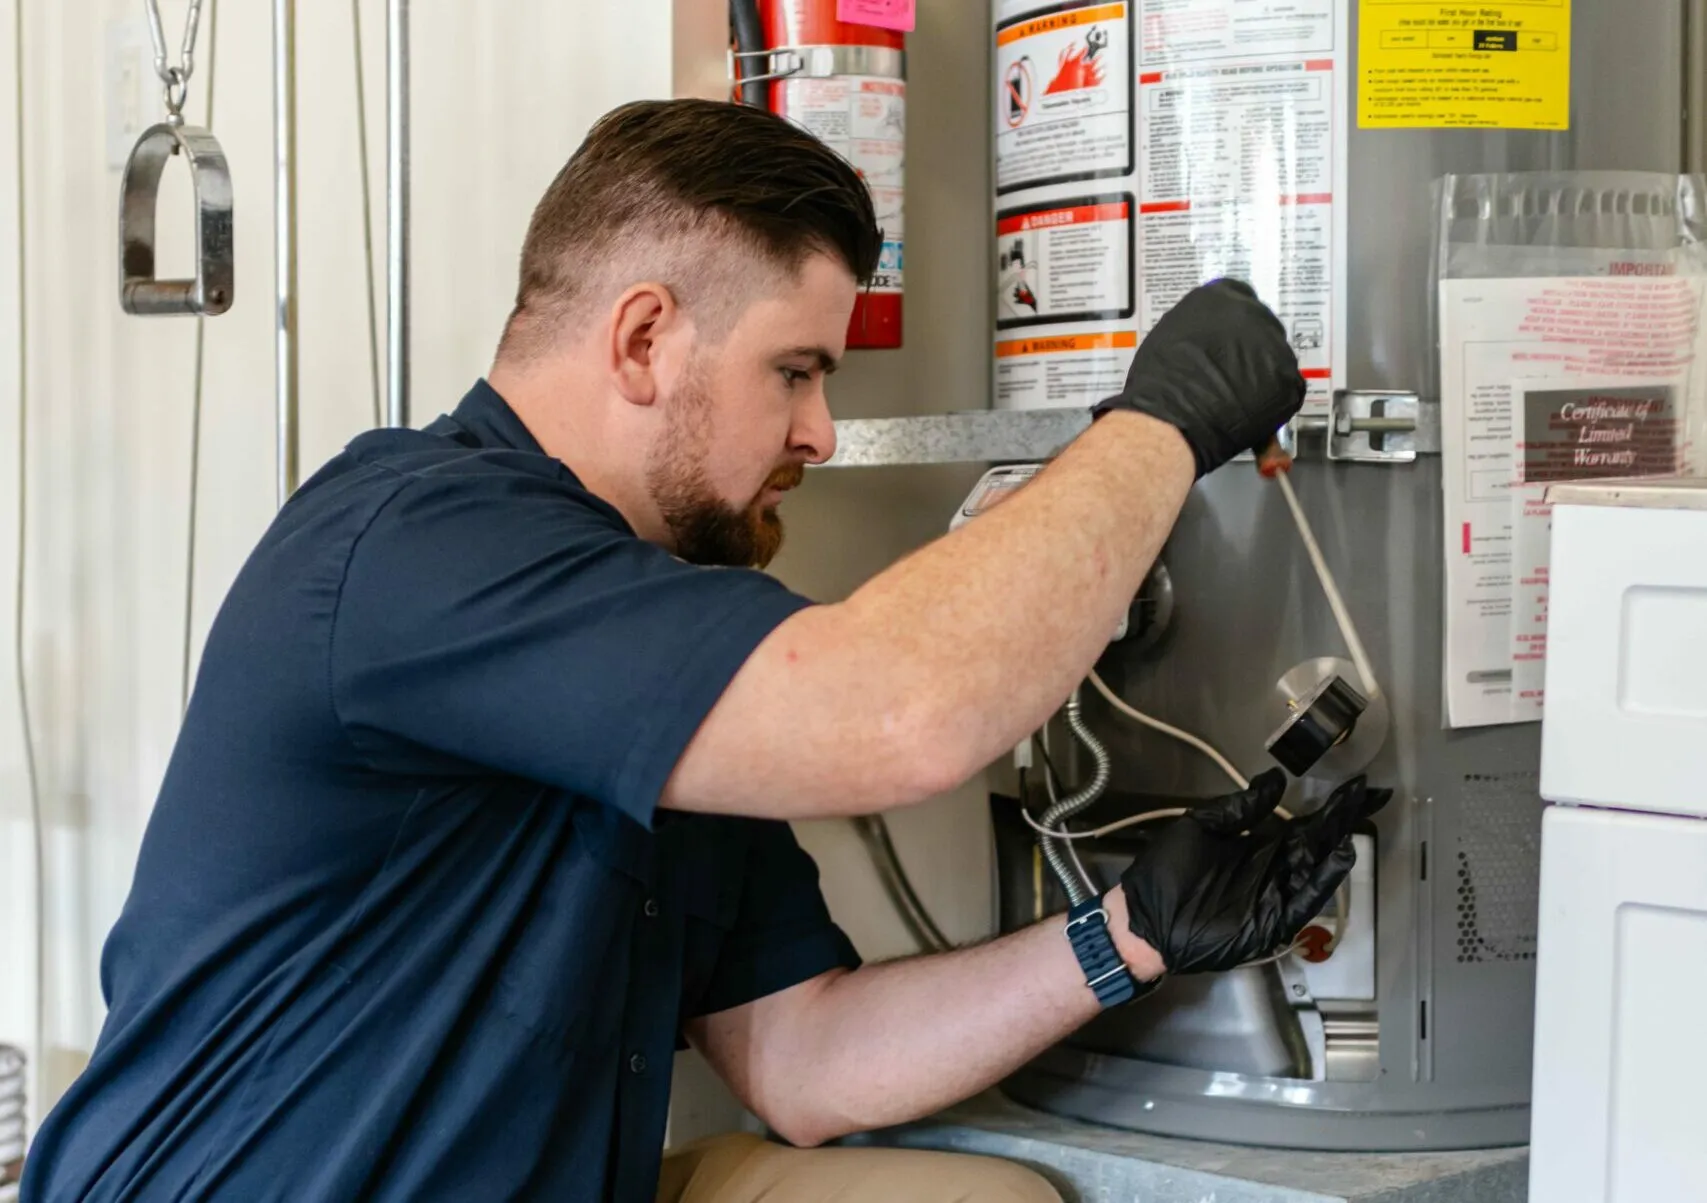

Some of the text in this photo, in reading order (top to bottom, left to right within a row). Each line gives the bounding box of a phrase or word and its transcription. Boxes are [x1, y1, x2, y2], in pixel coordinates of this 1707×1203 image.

[1440, 8, 1457, 16] First
[1029, 13, 1077, 33] WARNING
[1031, 211, 1074, 227] DANGER
[1032, 338, 1076, 352] WARNING
[1560, 402, 1630, 423] Certificate
[1635, 399, 1653, 421] of
[1578, 423, 1633, 444] Limited
[1573, 448, 1638, 467] Warranty
